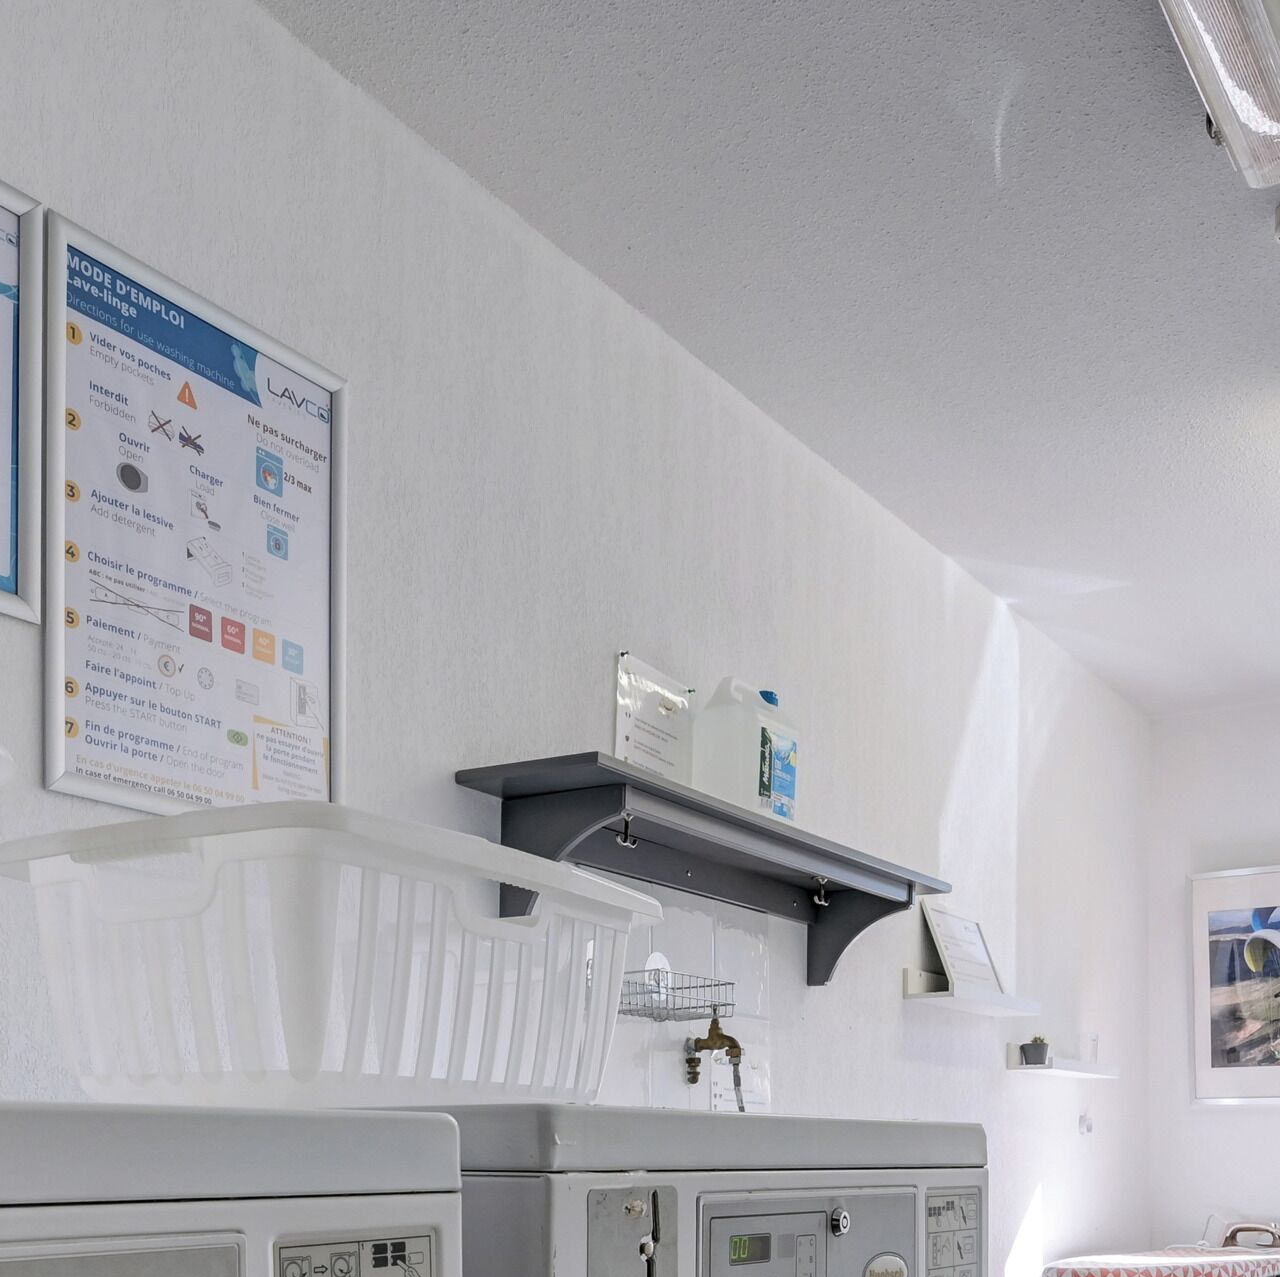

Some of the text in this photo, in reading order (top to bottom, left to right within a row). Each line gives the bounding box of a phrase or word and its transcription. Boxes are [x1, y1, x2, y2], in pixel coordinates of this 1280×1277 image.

[68, 251, 184, 328] MODE D'EMPLOI
[70, 326, 171, 380] 1 Vider vos poches
[120, 319, 134, 333] for
[138, 330, 154, 345] use
[157, 341, 194, 370] washing
[197, 363, 235, 390] machine
[284, 472, 312, 494] 2/3 max
[88, 551, 192, 597] Choisir le programme
